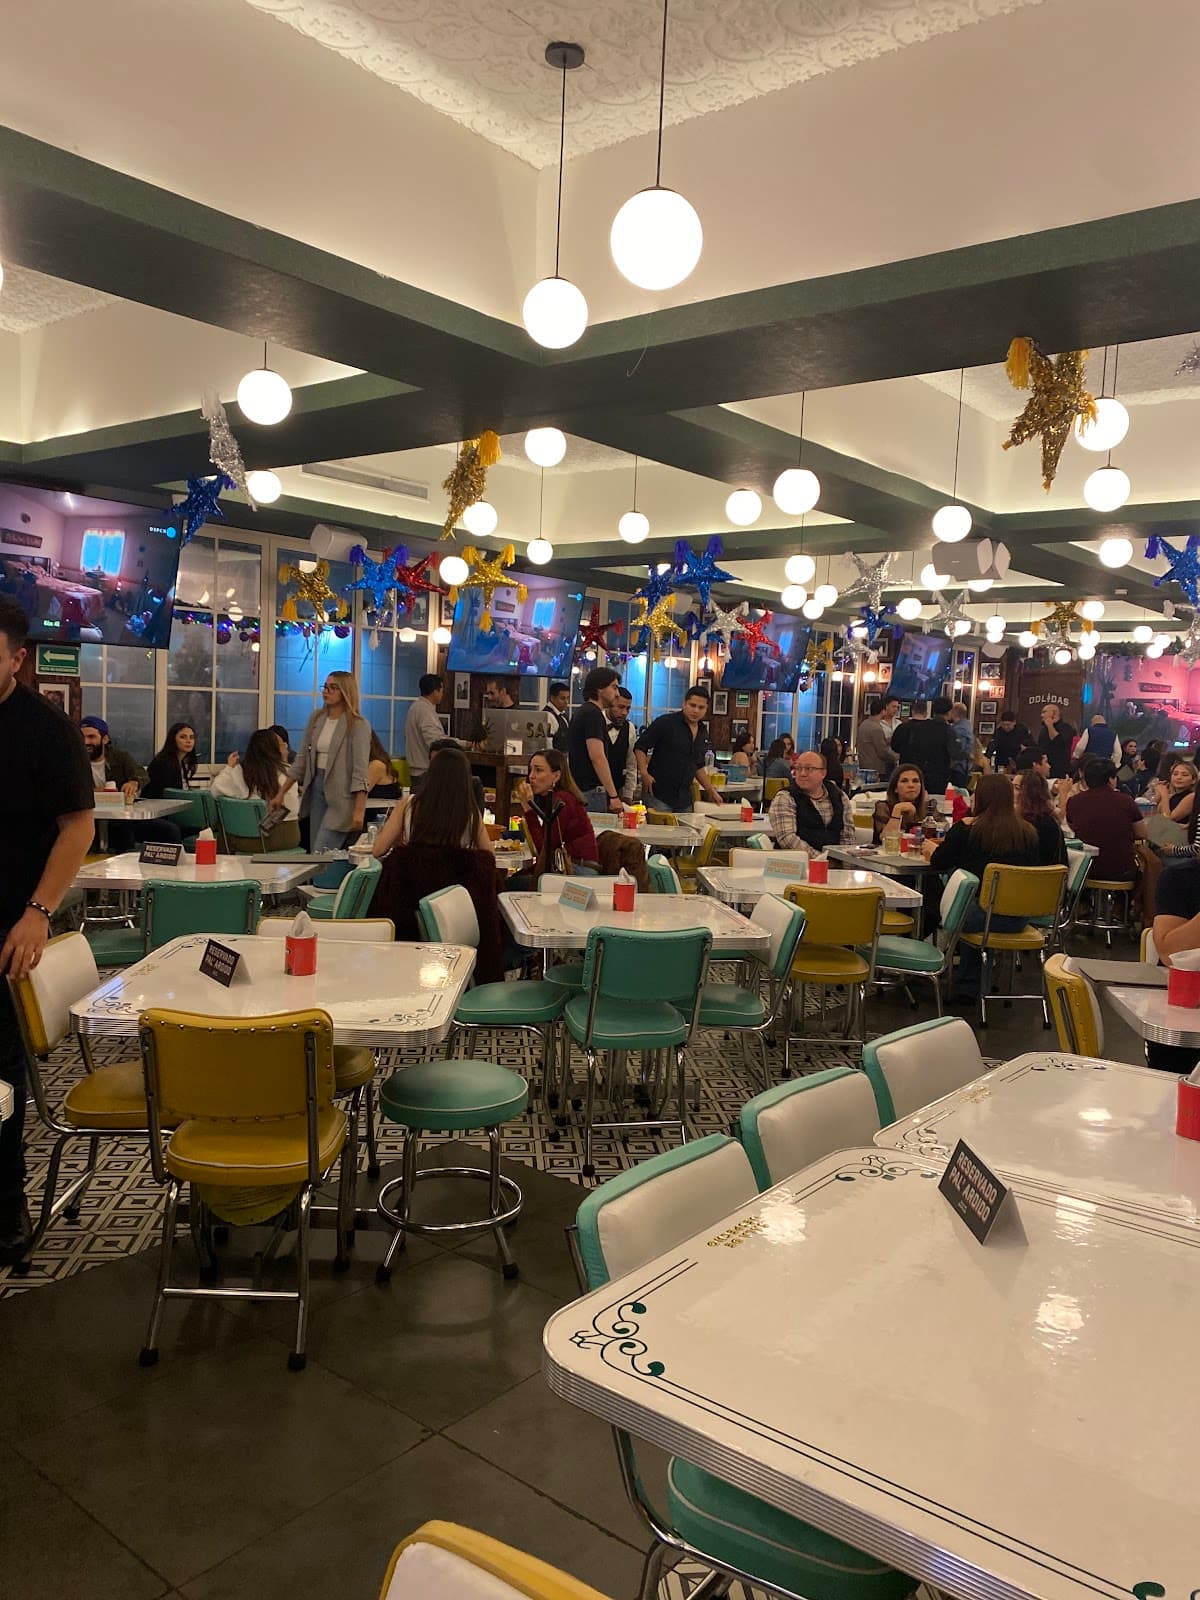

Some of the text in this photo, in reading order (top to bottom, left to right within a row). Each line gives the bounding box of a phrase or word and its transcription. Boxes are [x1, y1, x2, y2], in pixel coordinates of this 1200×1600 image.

[208, 944, 235, 965] RESERVADO
[956, 1151, 998, 1206] RESERVADO
[962, 1184, 991, 1223] ARDIDO
